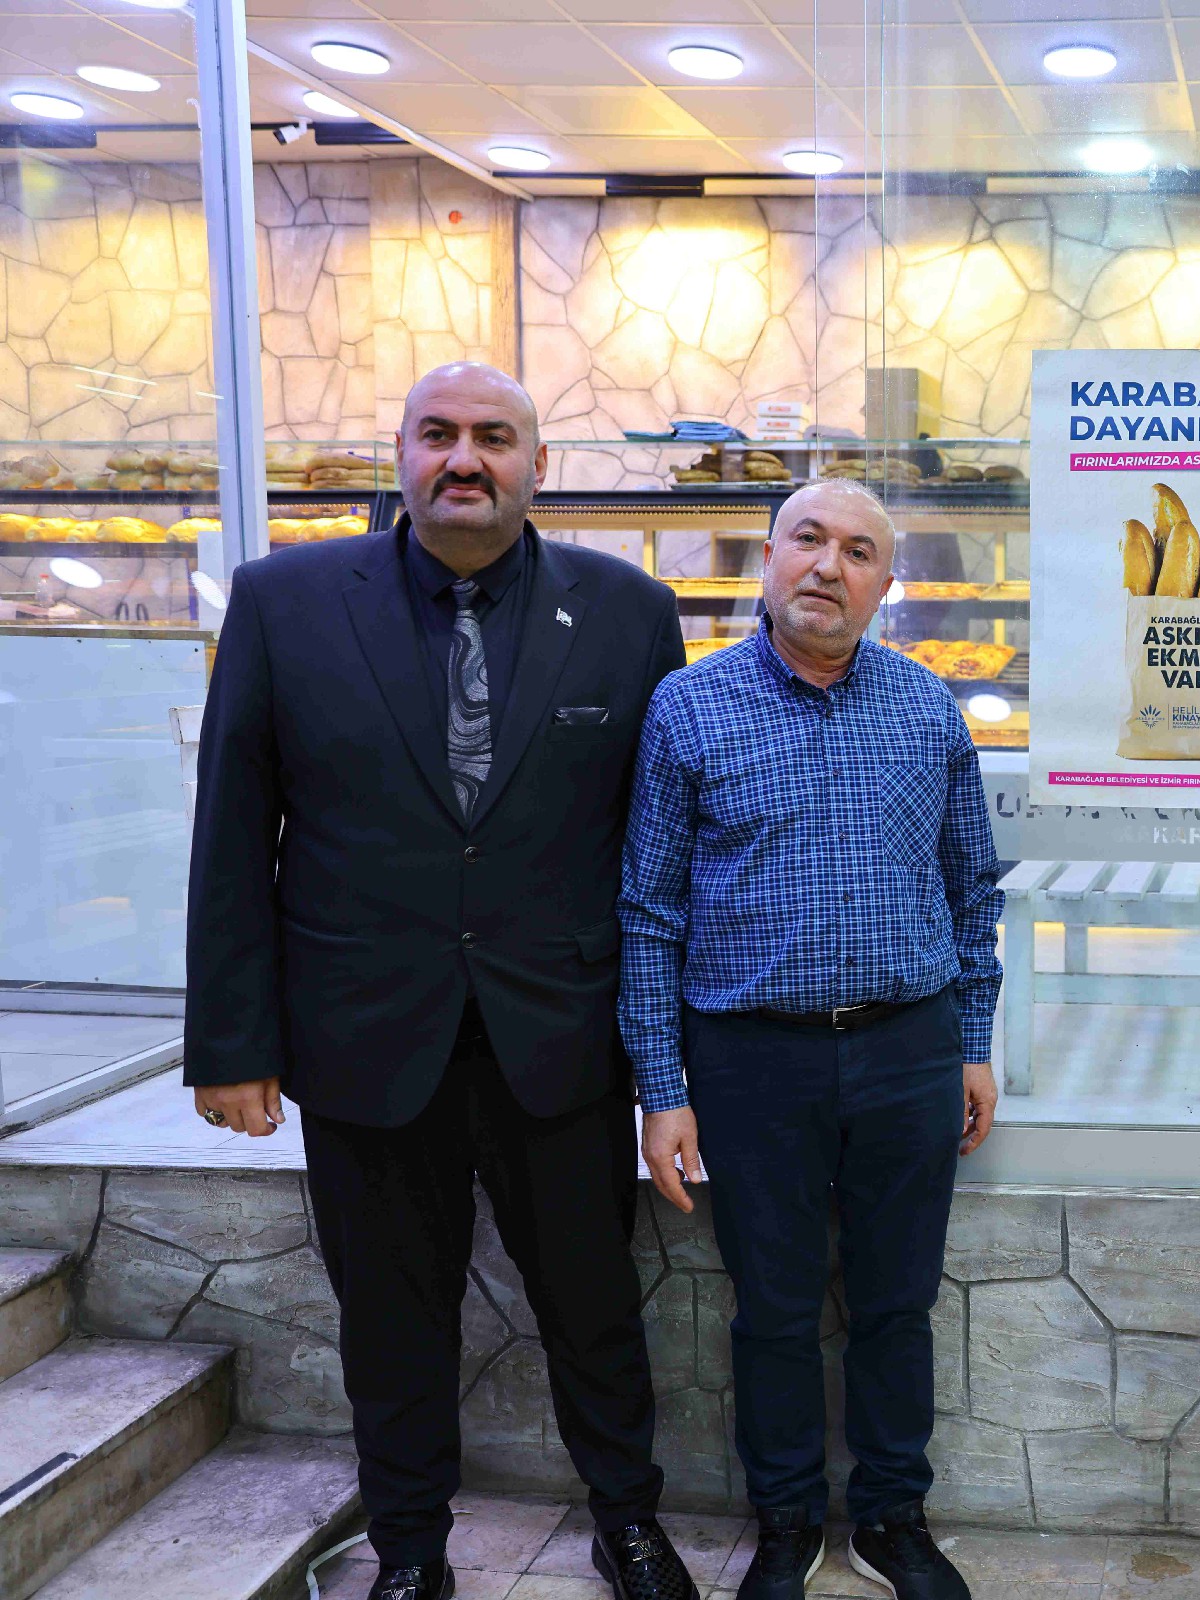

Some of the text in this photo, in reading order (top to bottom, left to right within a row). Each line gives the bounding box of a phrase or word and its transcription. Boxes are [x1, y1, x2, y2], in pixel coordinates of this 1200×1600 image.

[1074, 455, 1183, 467] FIRINLARIMIZDA
[1172, 705, 1200, 714] HELİL
[1055, 775, 1105, 783] KARABAĞLAR
[1106, 776, 1148, 784] BELEDİYESİ
[1160, 776, 1181, 785] İZMİR
